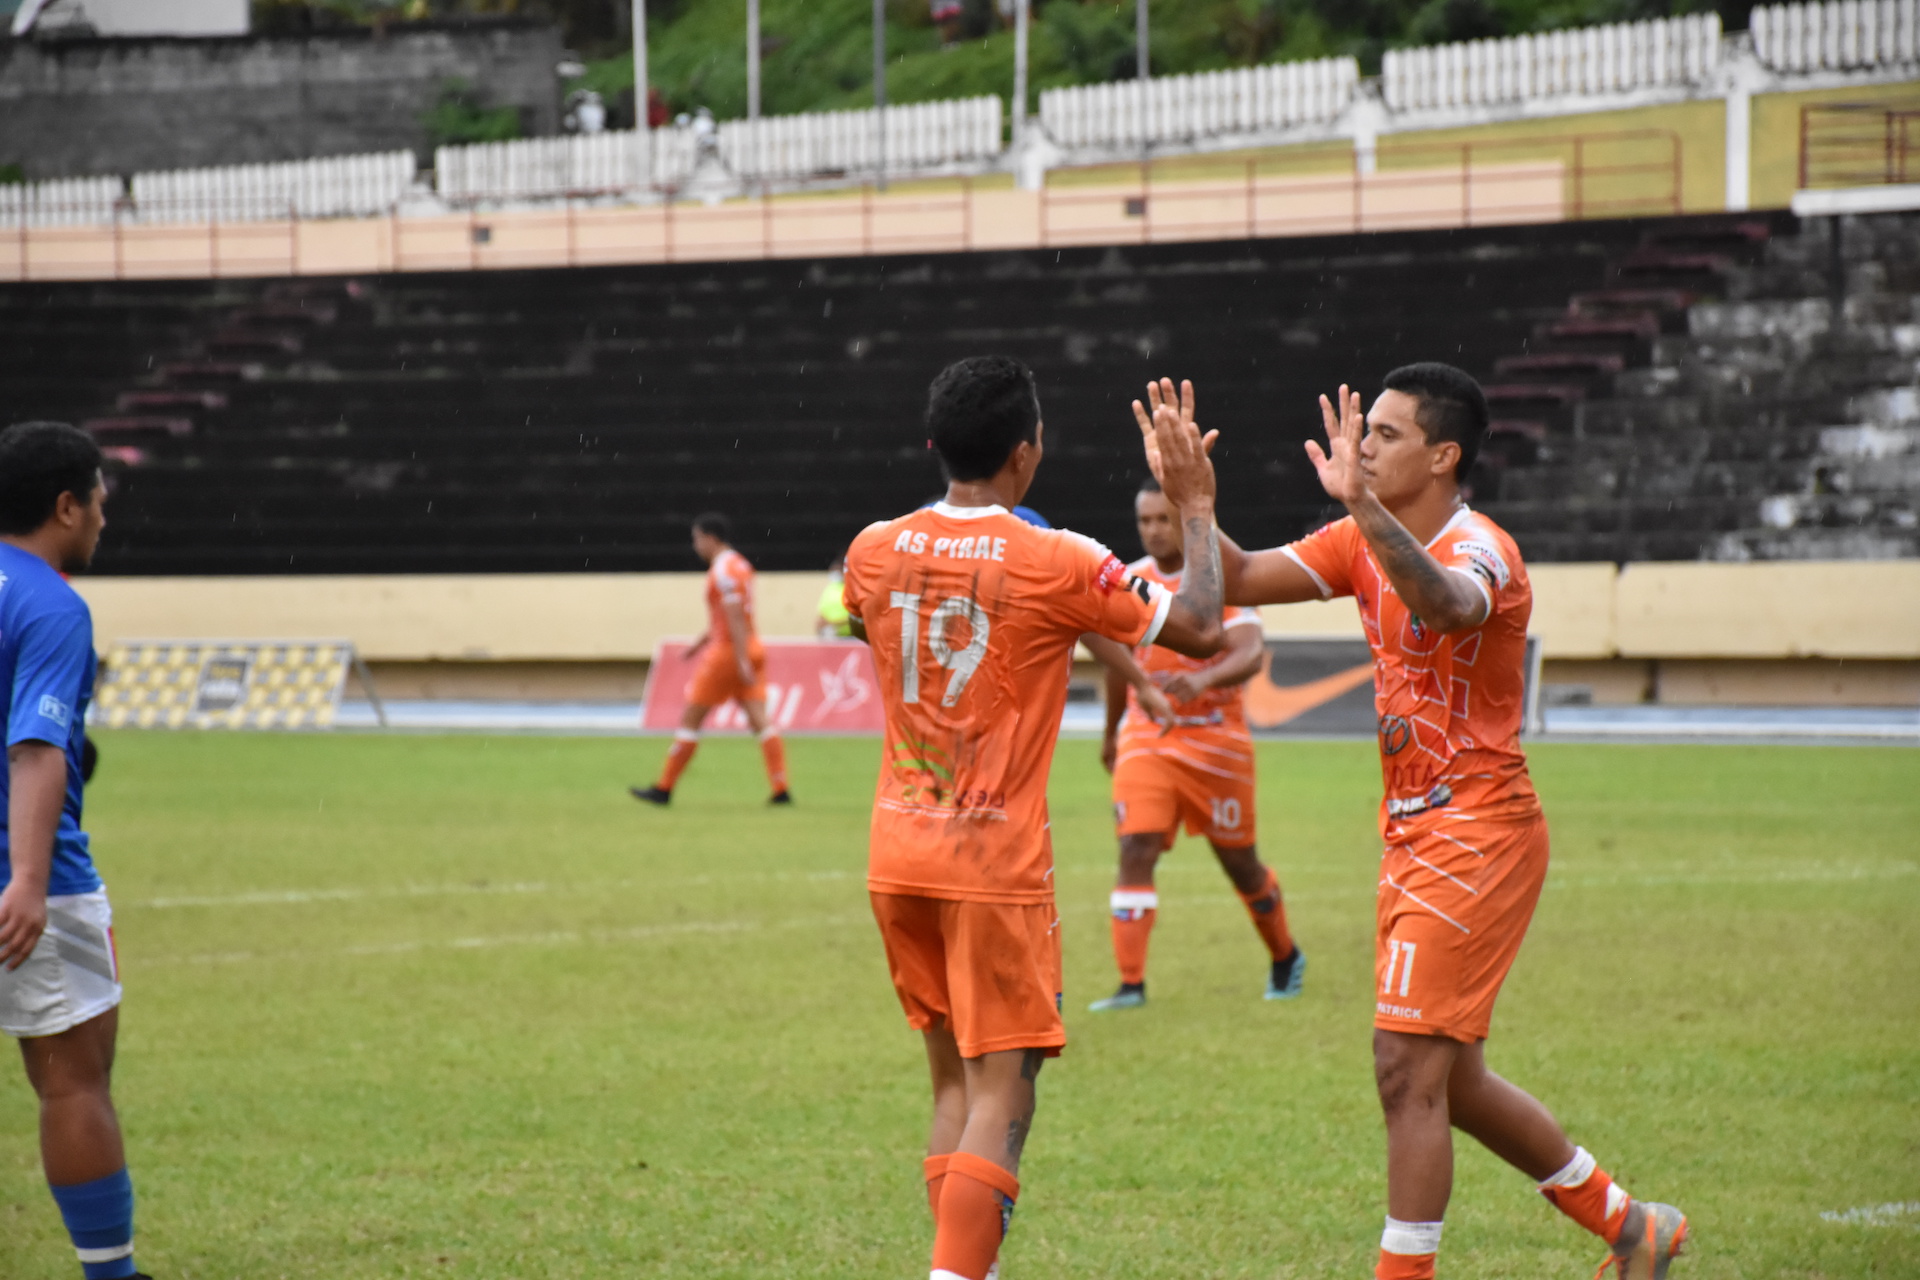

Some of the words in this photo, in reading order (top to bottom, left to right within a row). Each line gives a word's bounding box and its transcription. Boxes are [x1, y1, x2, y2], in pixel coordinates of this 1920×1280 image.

[894, 530, 928, 554] AS
[934, 536, 1008, 562] PIRAE
[890, 591, 990, 707] 19
[1210, 797, 1241, 828] 10
[1384, 940, 1416, 997] 11
